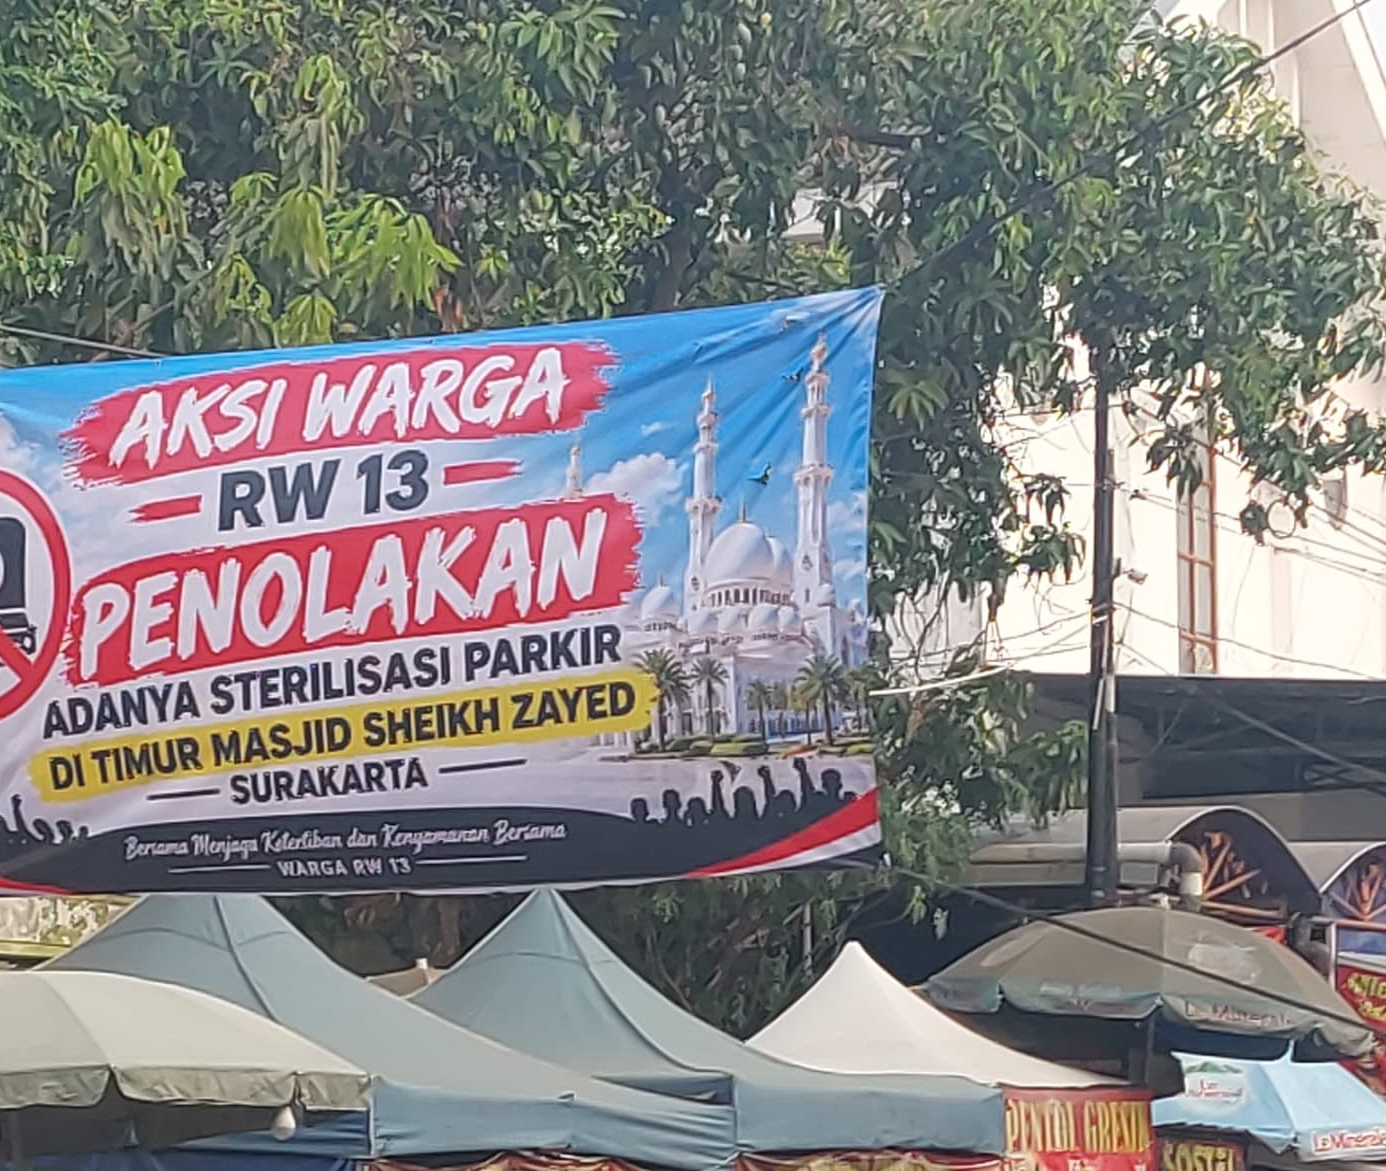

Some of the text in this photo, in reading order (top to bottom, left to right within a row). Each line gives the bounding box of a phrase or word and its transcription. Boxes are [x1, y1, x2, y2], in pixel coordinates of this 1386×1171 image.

[109, 347, 570, 470] AKSI WARGA
[217, 449, 430, 532] RW 13
[78, 508, 609, 681] PENOLAKAN
[42, 624, 622, 741] ADANYA STERILISASI PARKIR
[47, 680, 637, 792] DI TIMUR MASJID SHEIKH ZAYED
[229, 756, 429, 806] SURAKARTA
[124, 819, 568, 862] Bersama Menjaga Ketertiban dan Kenyamanan Bersama
[276, 856, 413, 878] WARGA RW 13
